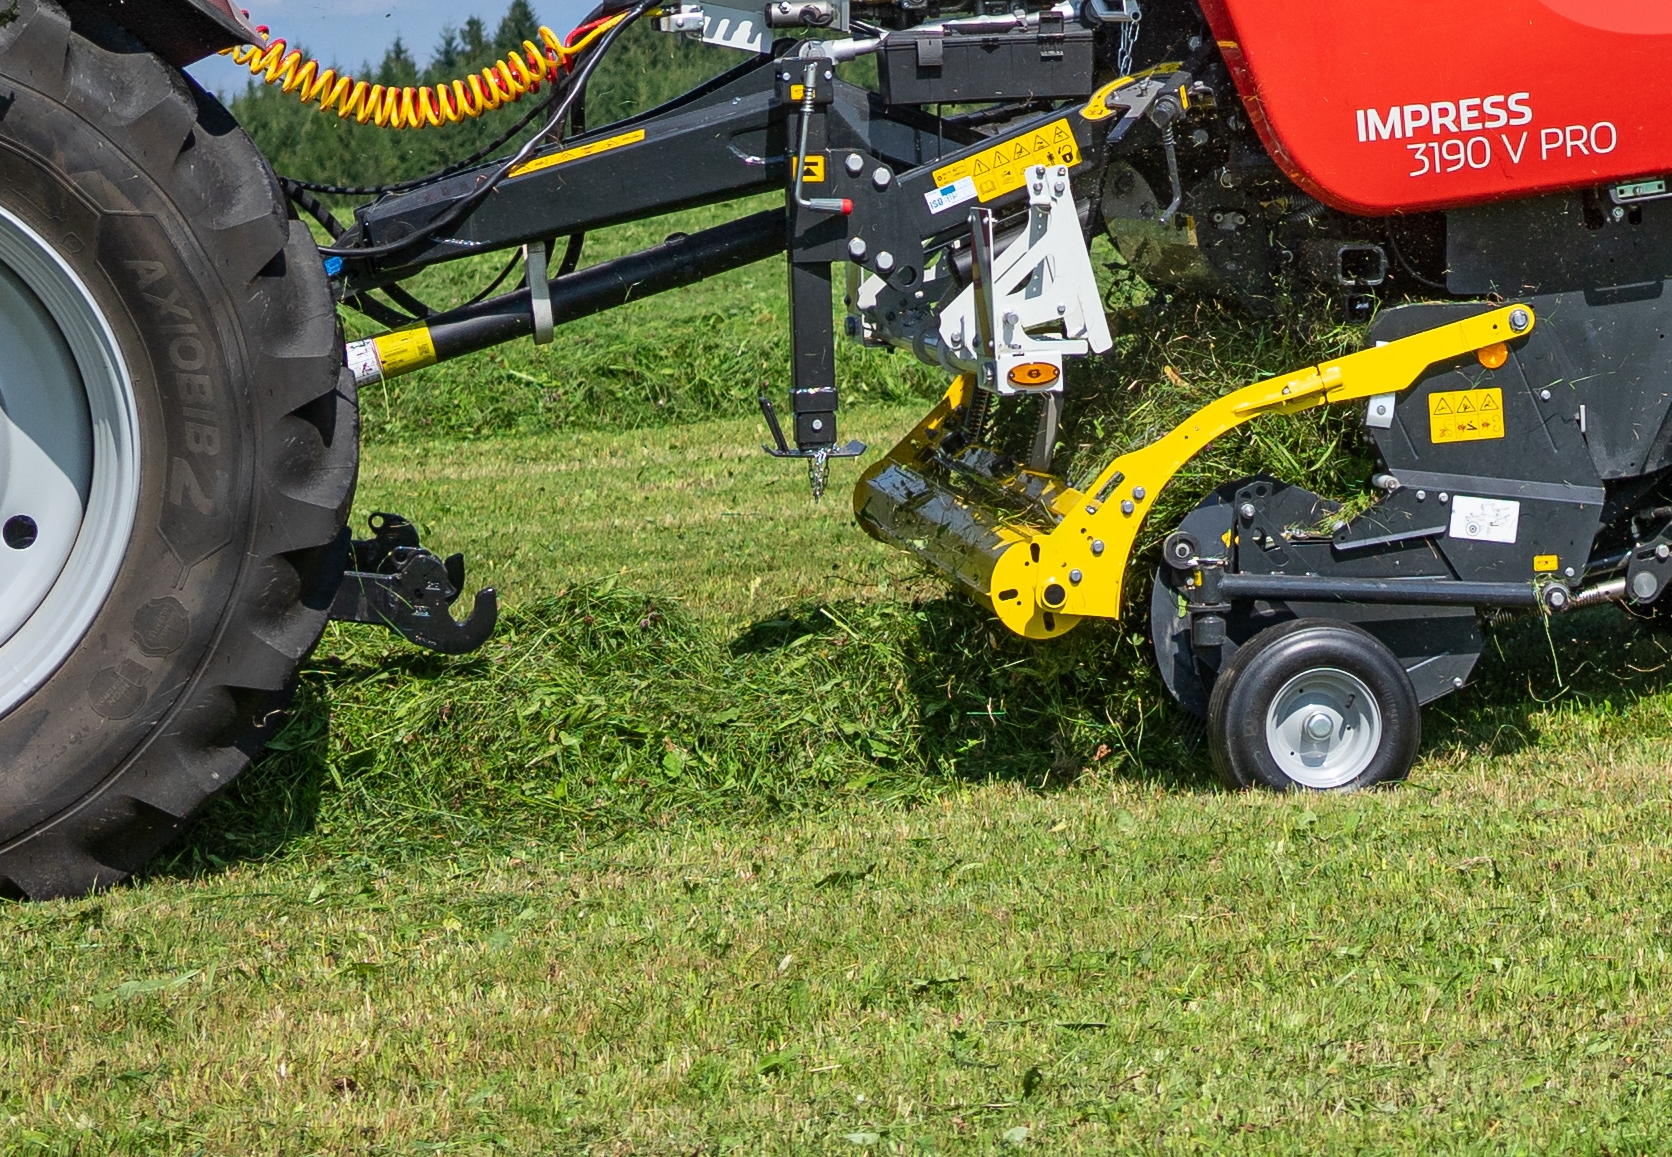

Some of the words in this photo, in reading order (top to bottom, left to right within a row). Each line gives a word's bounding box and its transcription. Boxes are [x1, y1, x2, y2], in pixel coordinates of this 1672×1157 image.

[1356, 92, 1533, 142] IMPRESS
[1406, 136, 1491, 177] 3190
[1501, 131, 1528, 164] V
[1540, 121, 1617, 161] PRO
[123, 260, 220, 456] AXIOBIB
[168, 456, 229, 516] 2
